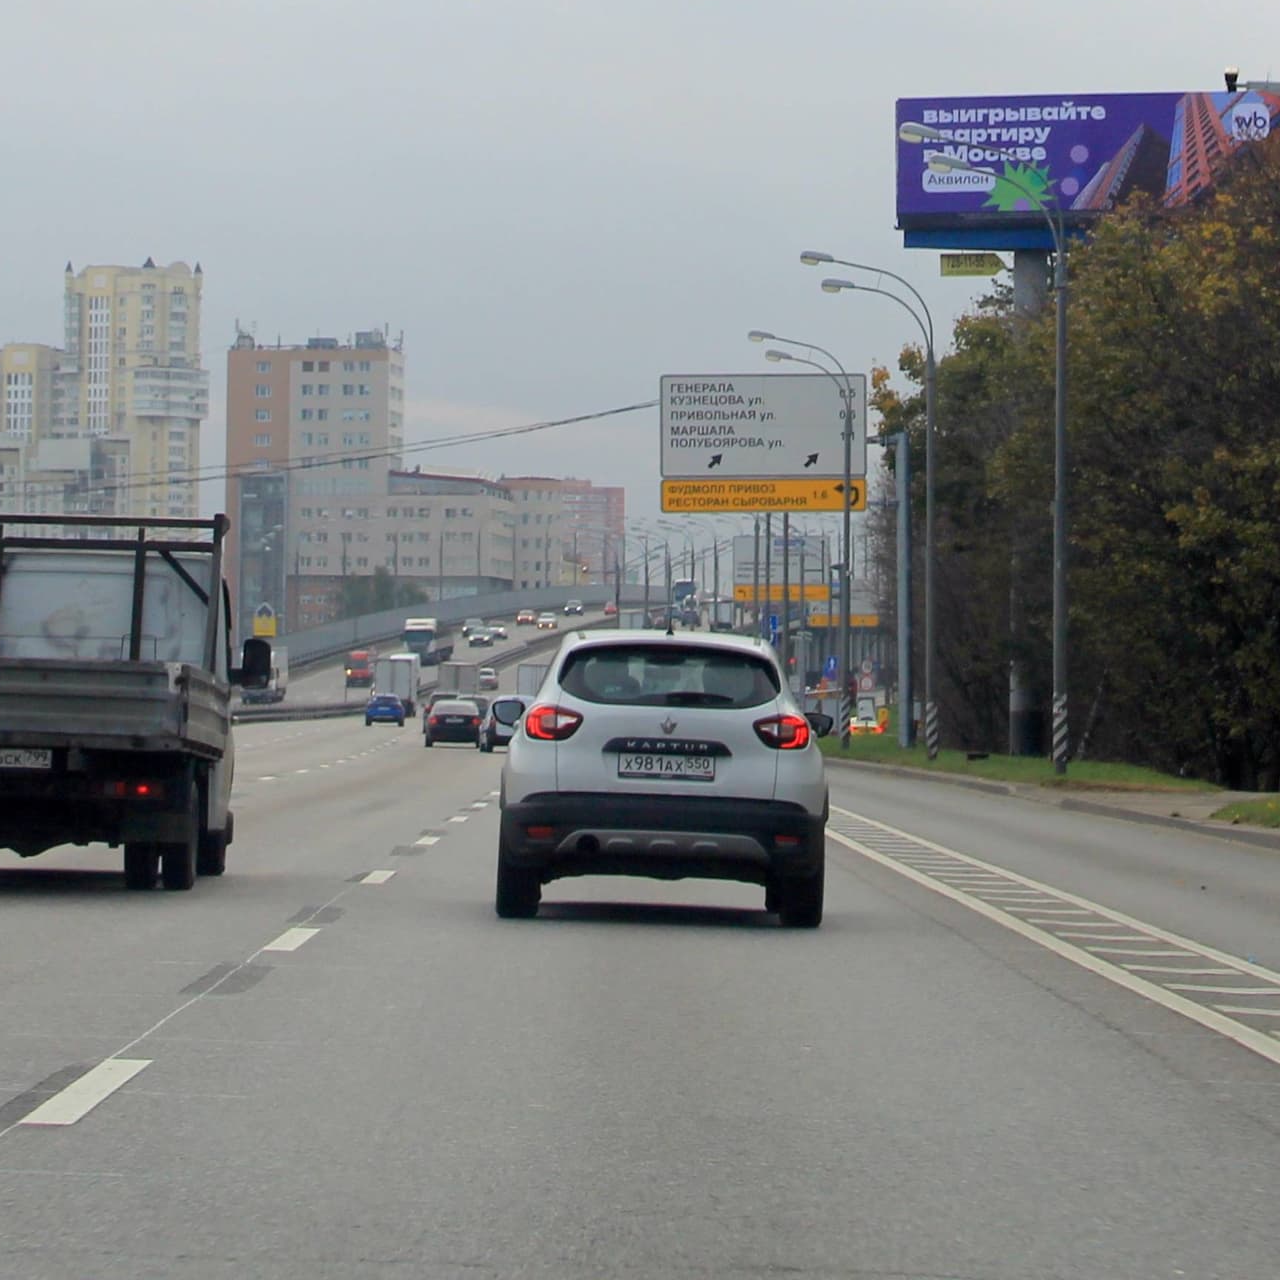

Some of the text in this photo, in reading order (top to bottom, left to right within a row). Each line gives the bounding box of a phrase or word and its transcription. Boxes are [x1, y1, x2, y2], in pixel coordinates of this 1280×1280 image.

[923, 102, 1106, 125] выигрывайте
[1235, 110, 1267, 129] wb
[943, 145, 1047, 163] Москве
[927, 172, 990, 186] Аквилон
[670, 383, 734, 393] ГЕНЕРАЛА
[670, 395, 765, 407] КУЗНЕЦОВА ул.
[670, 410, 776, 422] ПРИВОЛЬНАЯ ул.
[670, 426, 735, 436] МАРШАЛА
[670, 438, 785, 450] ПОЛУБОЯРОВА ул.
[668, 484, 776, 495] ФУДМОЛЛ ПРИВОЗ
[668, 496, 807, 507] РЕСТОРАН СЫРОВАРНЯ
[627, 741, 708, 751] KAPTUR
